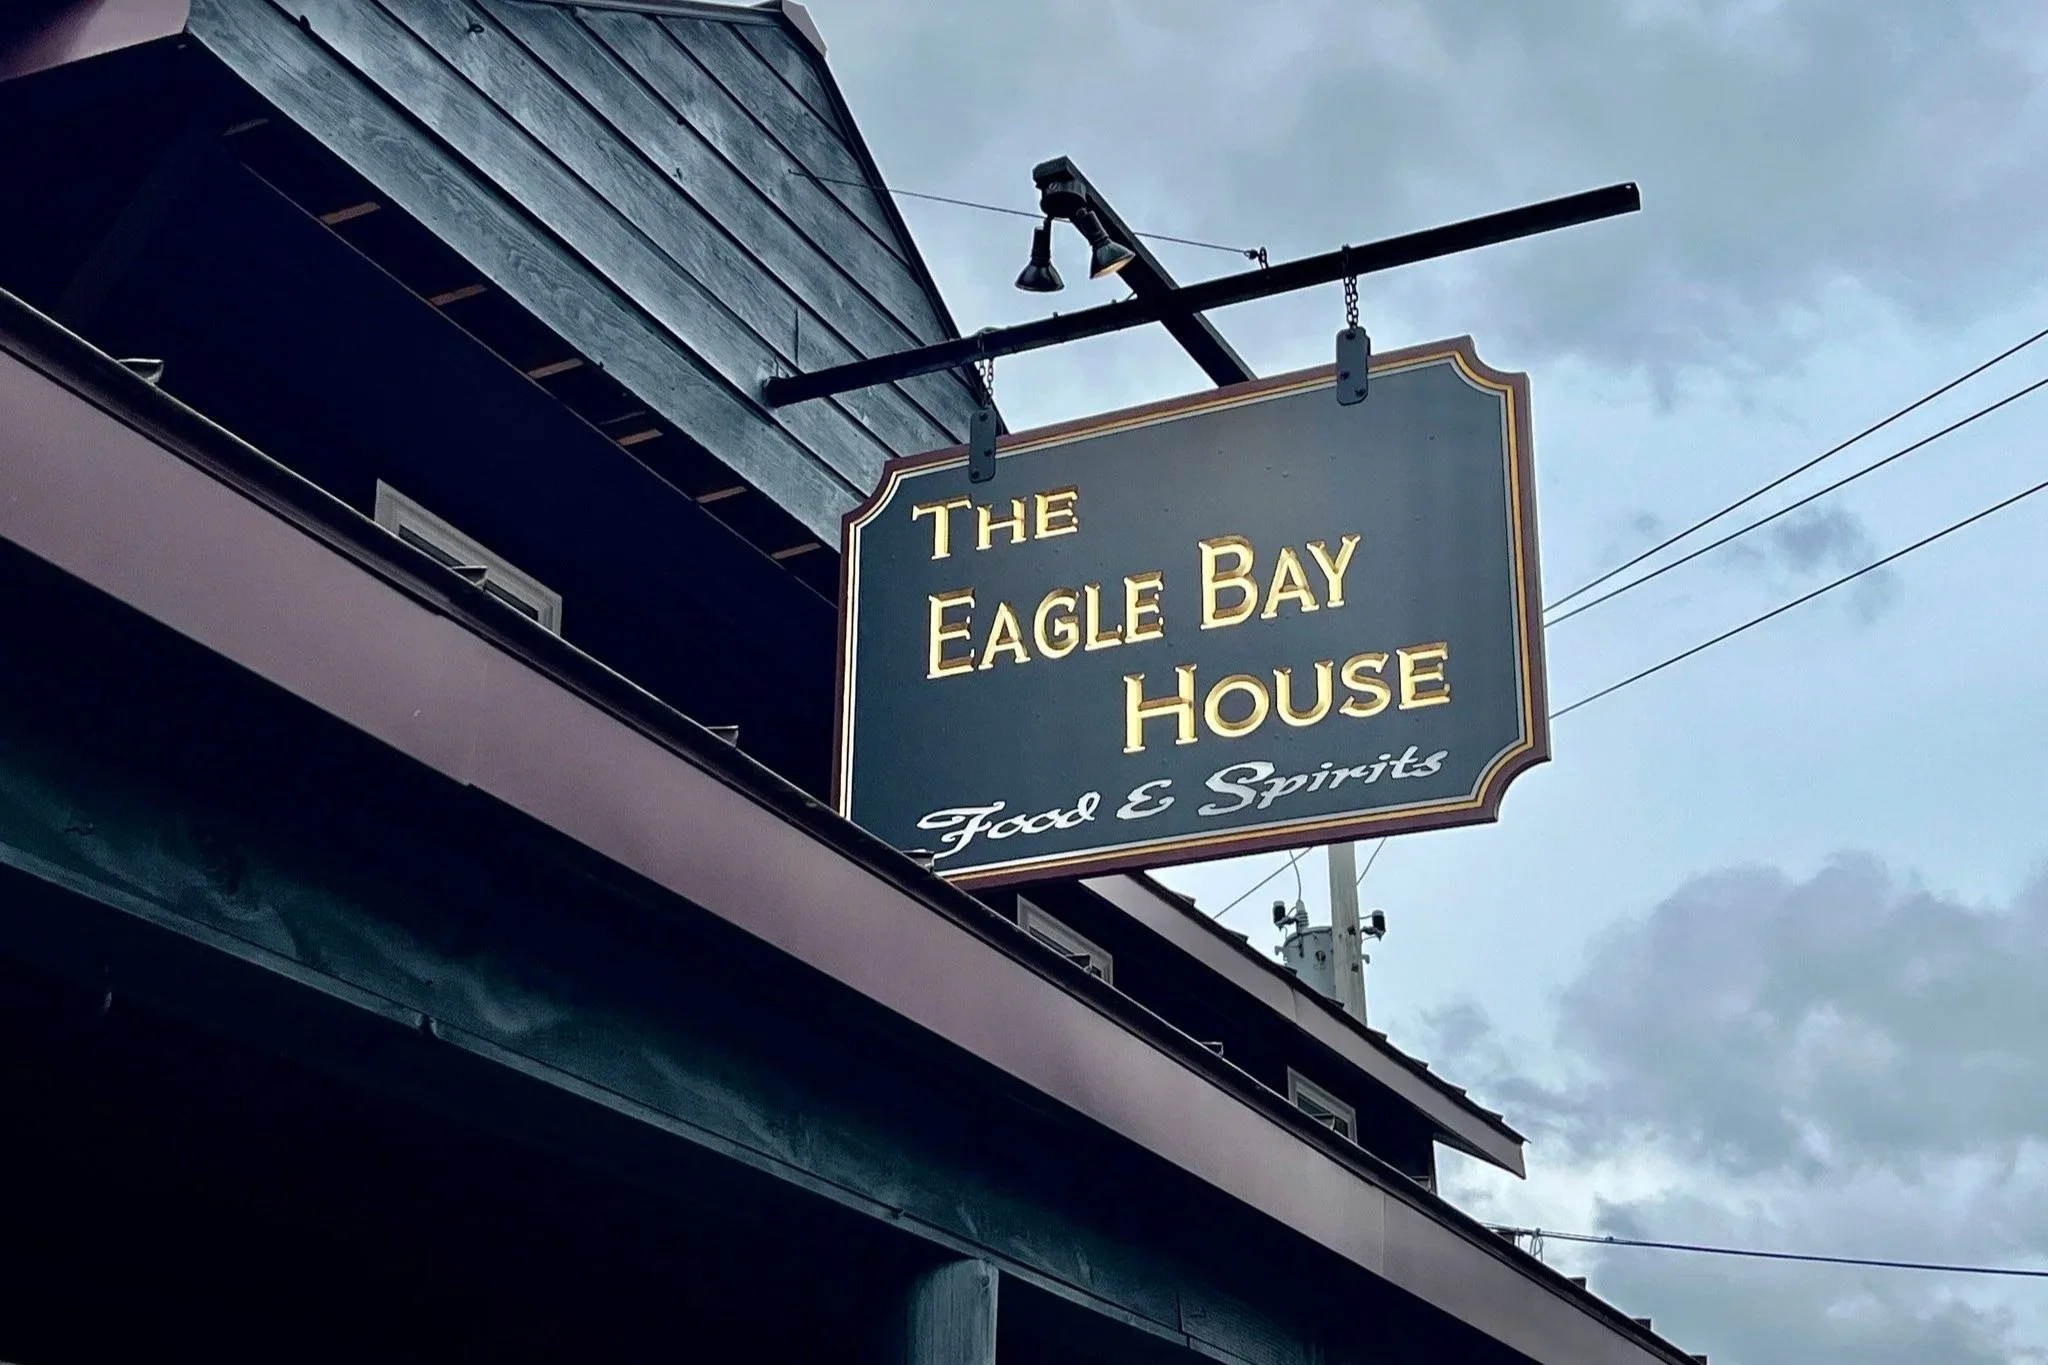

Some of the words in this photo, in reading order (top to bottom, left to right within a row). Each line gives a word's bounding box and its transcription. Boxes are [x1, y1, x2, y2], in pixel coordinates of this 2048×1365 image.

[911, 486, 1080, 561] THE
[926, 571, 1165, 680] EAGLE
[1198, 534, 1362, 631] BAY
[1123, 642, 1452, 754] HOUSE
[916, 791, 1101, 862] Food
[1115, 779, 1175, 820] &
[1197, 745, 1449, 816] Spirits
